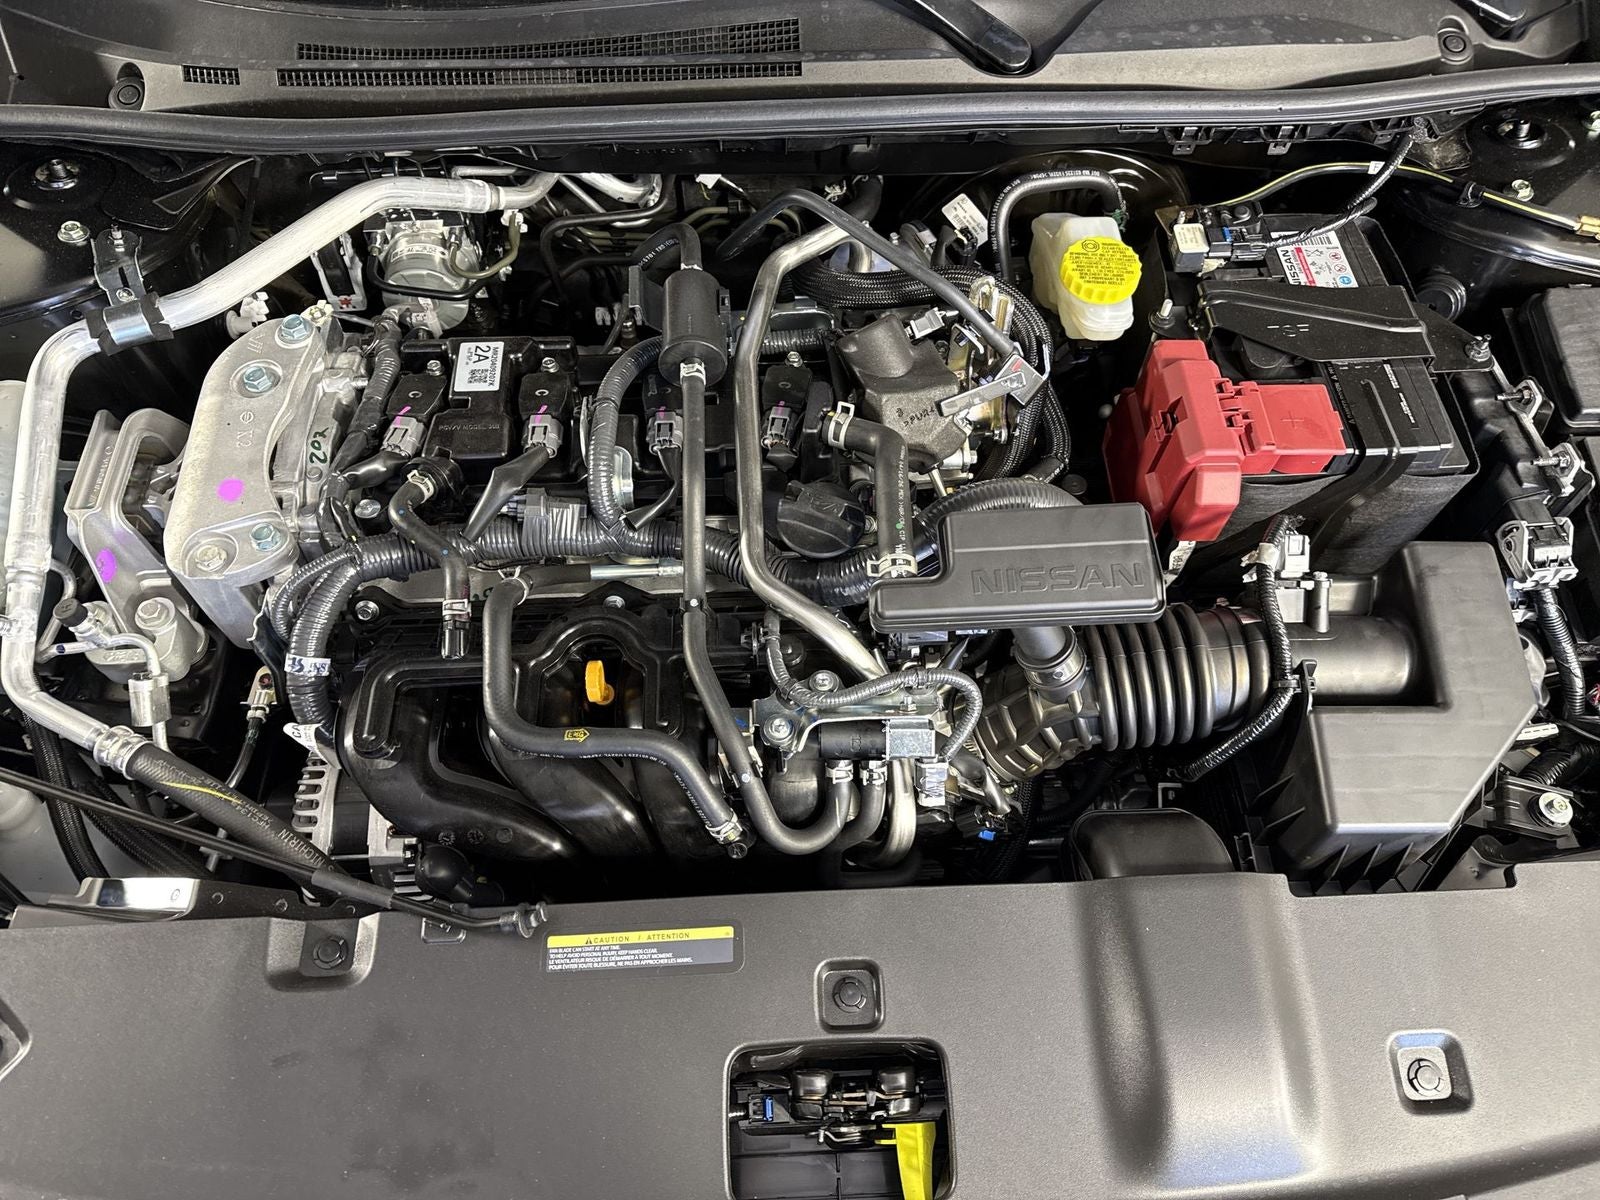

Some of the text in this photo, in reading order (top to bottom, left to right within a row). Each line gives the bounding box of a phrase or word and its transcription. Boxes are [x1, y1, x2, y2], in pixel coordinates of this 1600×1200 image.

[472, 345, 491, 364] 2A
[971, 562, 1144, 597] NISSAN
[278, 828, 325, 867] NICHIRIN
[646, 932, 690, 940] ATTENTION
